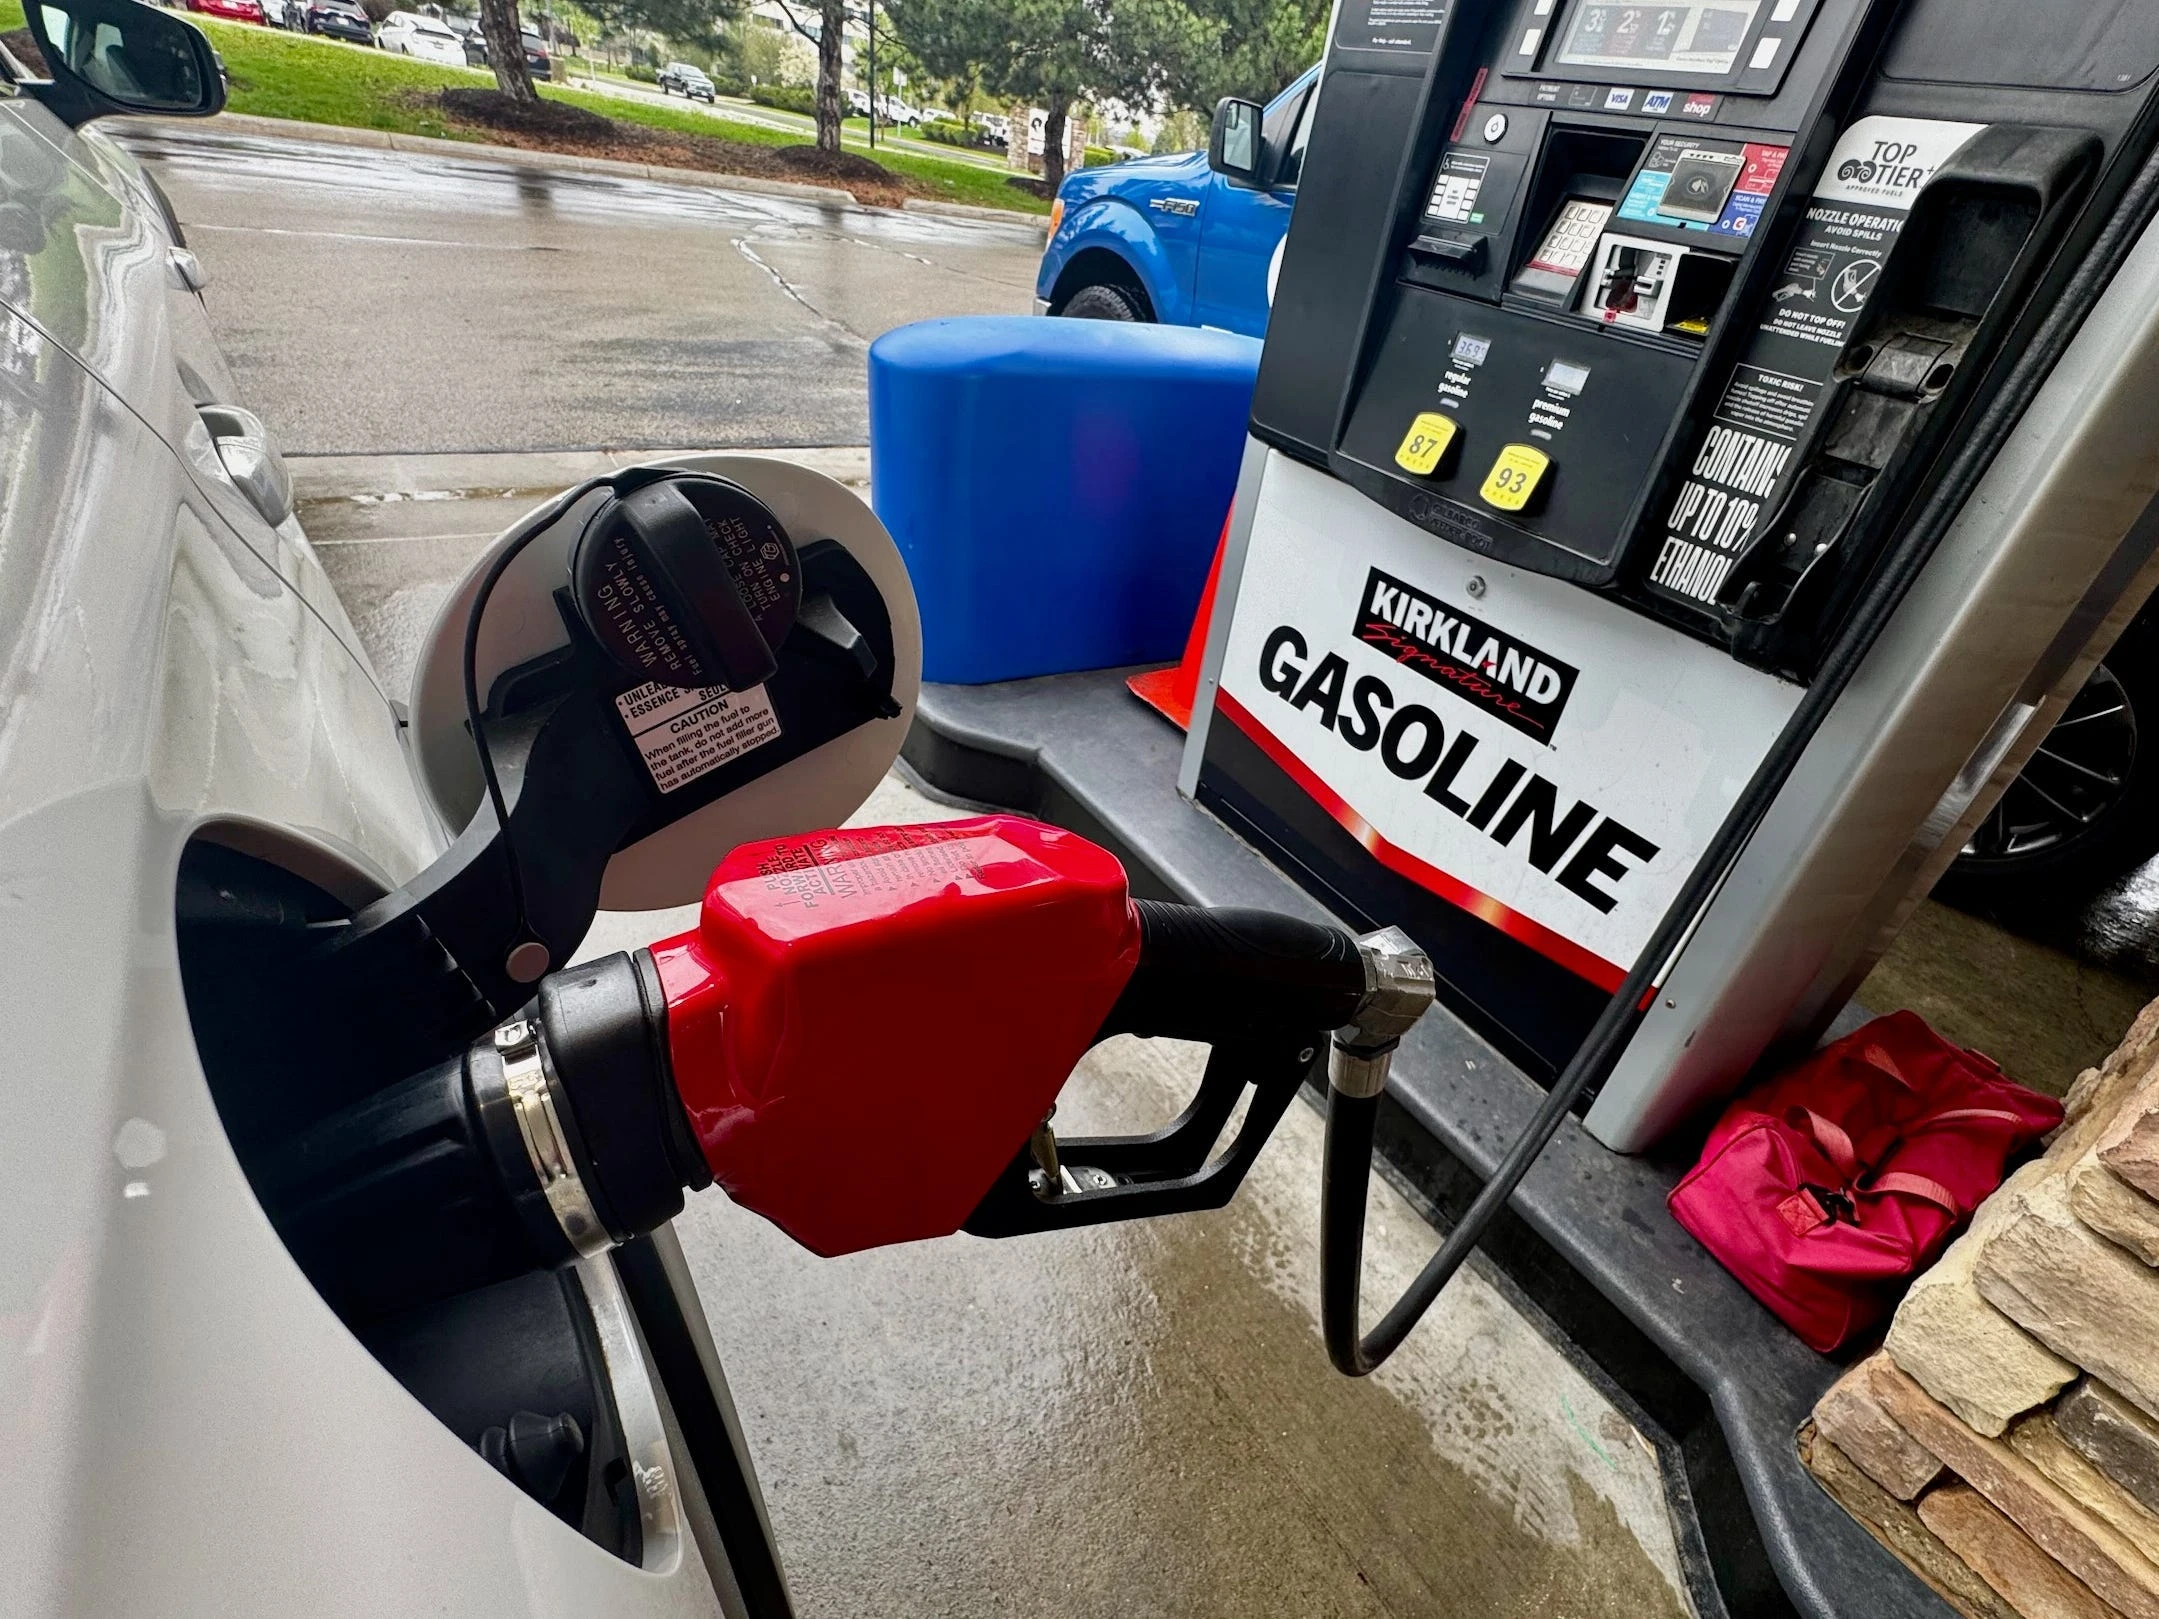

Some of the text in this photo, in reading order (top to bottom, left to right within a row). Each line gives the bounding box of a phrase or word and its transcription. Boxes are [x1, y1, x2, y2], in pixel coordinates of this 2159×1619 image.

[1611, 94, 1627, 104] VISA
[1645, 96, 1671, 108] ATM
[1683, 101, 1711, 117] shop
[1872, 141, 1917, 163] TOP
[1806, 208, 1849, 224] NOZZLE
[1825, 225, 1882, 241] AVOID SPILLS
[1773, 318, 1783, 326] DO
[1779, 308, 1846, 329] DO NOT TOP OFF!
[1437, 382, 1468, 398] gasoline
[1444, 370, 1472, 385] regular
[1759, 374, 1804, 392] TOXIC RISK!
[1528, 412, 1564, 430] gasoline
[1532, 399, 1571, 418] premium
[1409, 434, 1437, 458] 87
[1495, 467, 1527, 494] 93
[1667, 481, 1705, 532] UP
[1690, 488, 1728, 541] TO
[717, 519, 771, 611] TURN ON CHECK
[730, 517, 781, 602] ENGINE LIGHT
[733, 573, 754, 609] LOOSE
[598, 585, 657, 668] WARNING
[606, 562, 682, 671] REMOVE SLOWLY
[1369, 581, 1562, 705] KIRKLAND
[1362, 623, 1545, 729] Signature
[630, 688, 681, 718] ESSENCE
[670, 699, 729, 734] CAUTION
[645, 705, 750, 761] When filling the fuel to
[651, 708, 769, 772] the tank, do not add more
[655, 718, 775, 782] fuel after the fuel filler gun
[660, 727, 780, 791] has automatically stopped.
[1259, 625, 1661, 915] GASOLINE
[757, 863, 780, 890] PUSH
[766, 855, 797, 894] NOZZLE
[773, 843, 819, 908] FORWARD TO
[790, 847, 826, 895] ACTIVATE
[810, 838, 857, 898] WARNING
